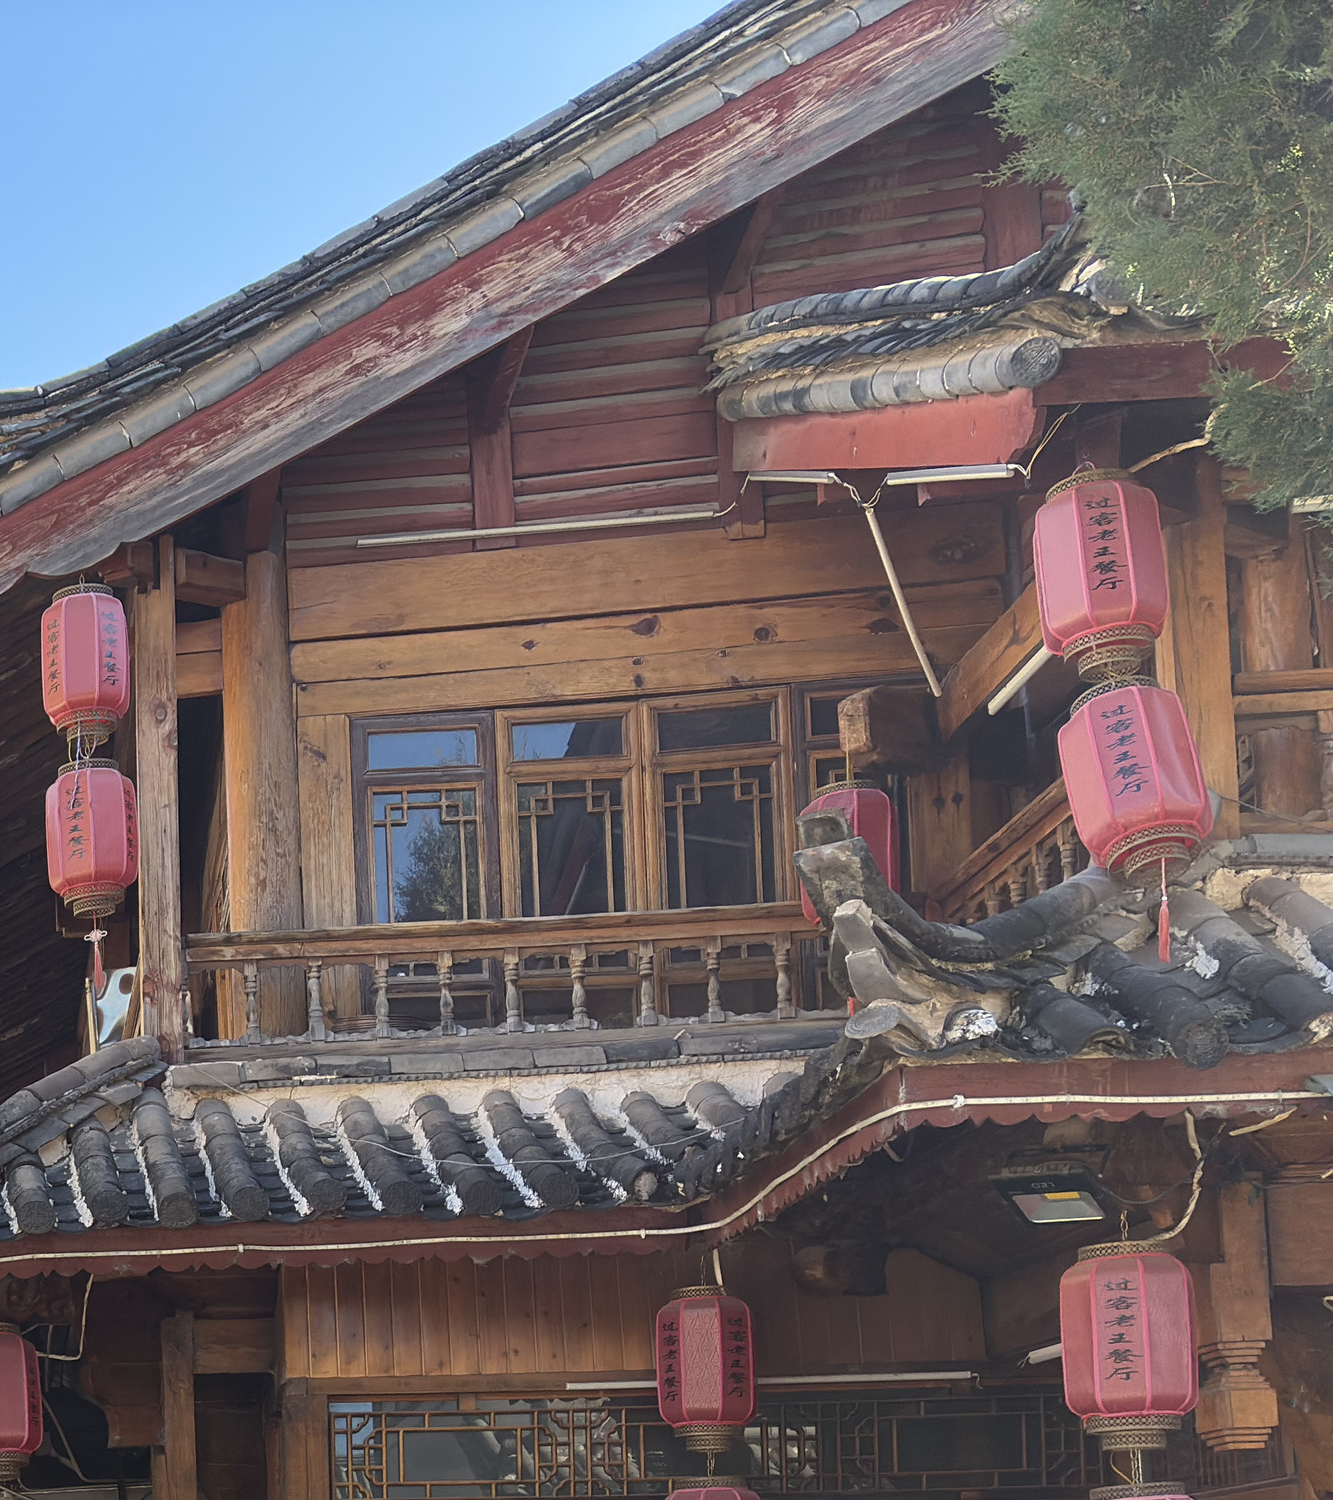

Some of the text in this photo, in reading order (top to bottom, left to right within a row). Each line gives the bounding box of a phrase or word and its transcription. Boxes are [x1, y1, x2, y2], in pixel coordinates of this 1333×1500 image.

[1085, 497, 1127, 591] 过客老王餐厅
[46, 619, 60, 695] 过客老王餐厅
[101, 610, 120, 687] 过客老王餐厅
[1101, 704, 1149, 797] 过客老王餐厅
[65, 786, 88, 860] 过客老王餐厅
[663, 1322, 680, 1402] 过客老王餐厅
[727, 1317, 746, 1398] 过客老王餐厅
[1103, 1278, 1142, 1382] 过客老王餐厅
